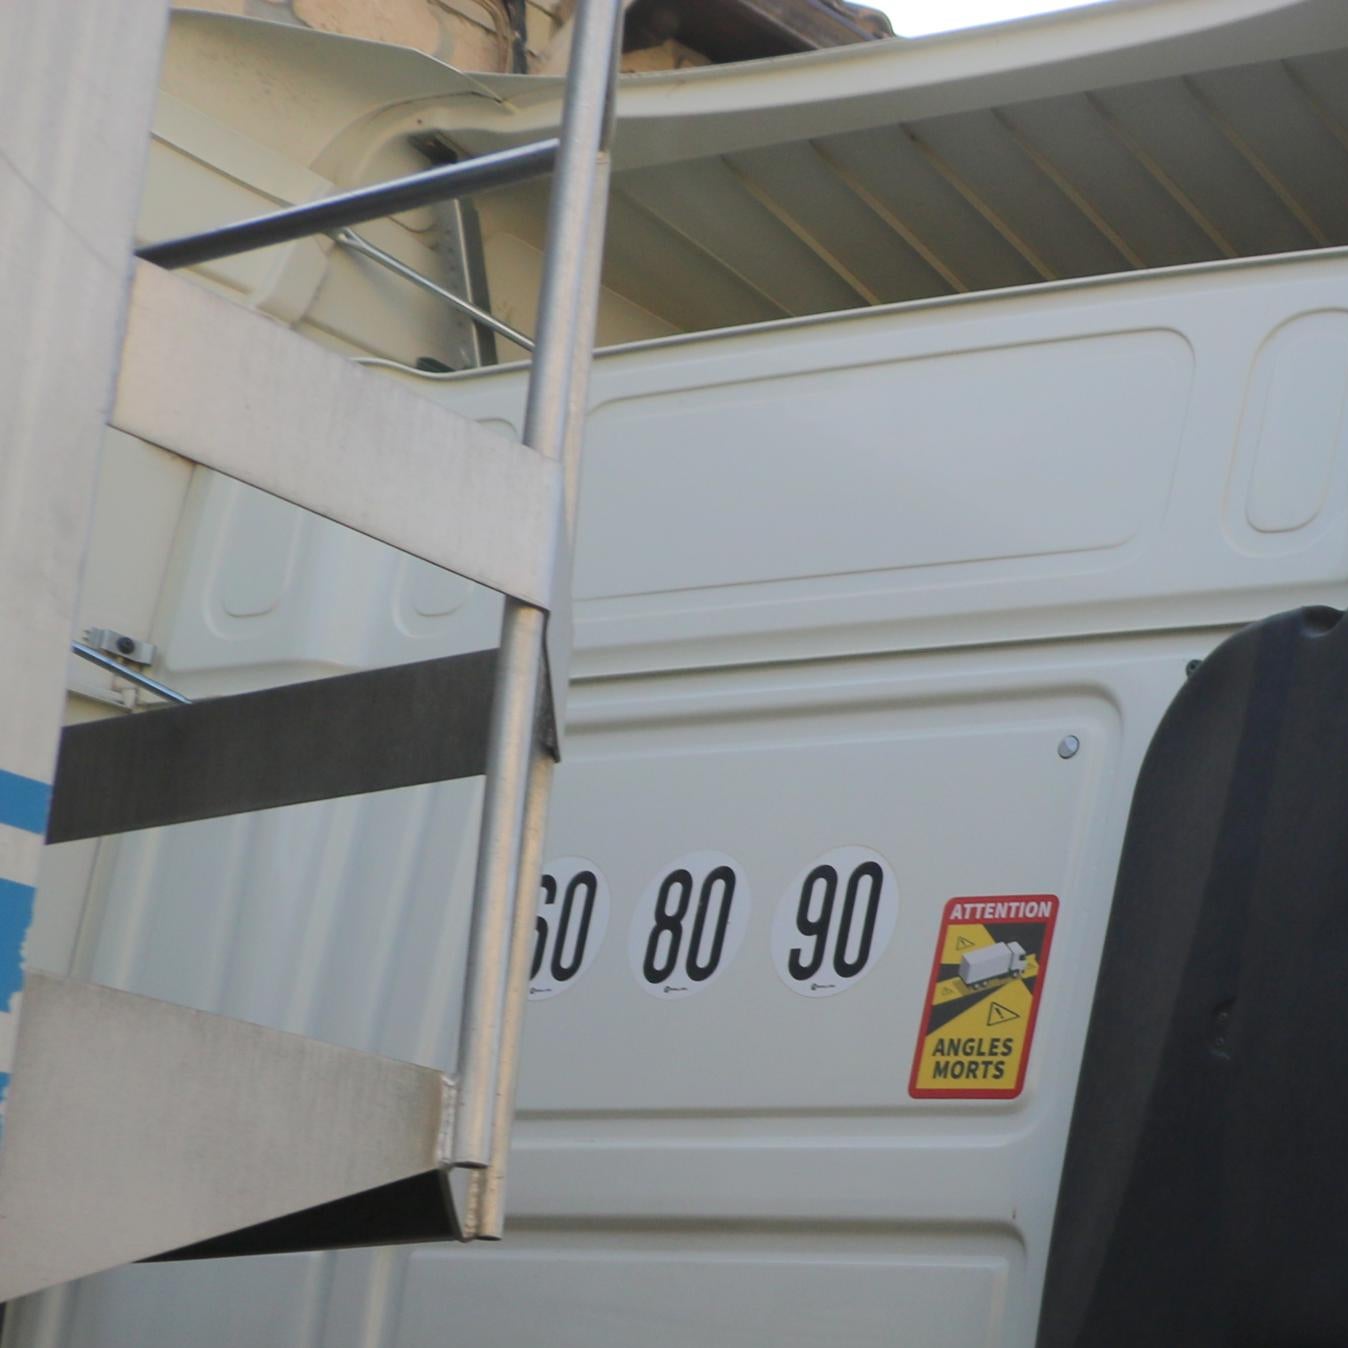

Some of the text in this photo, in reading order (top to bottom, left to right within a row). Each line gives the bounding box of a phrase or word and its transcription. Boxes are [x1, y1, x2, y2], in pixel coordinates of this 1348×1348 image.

[949, 901, 1052, 920] ATTENTION
[643, 866, 736, 984] 80
[788, 861, 884, 981] 90
[932, 1038, 1014, 1056] ANGLES
[932, 1060, 1006, 1080] MORTS
